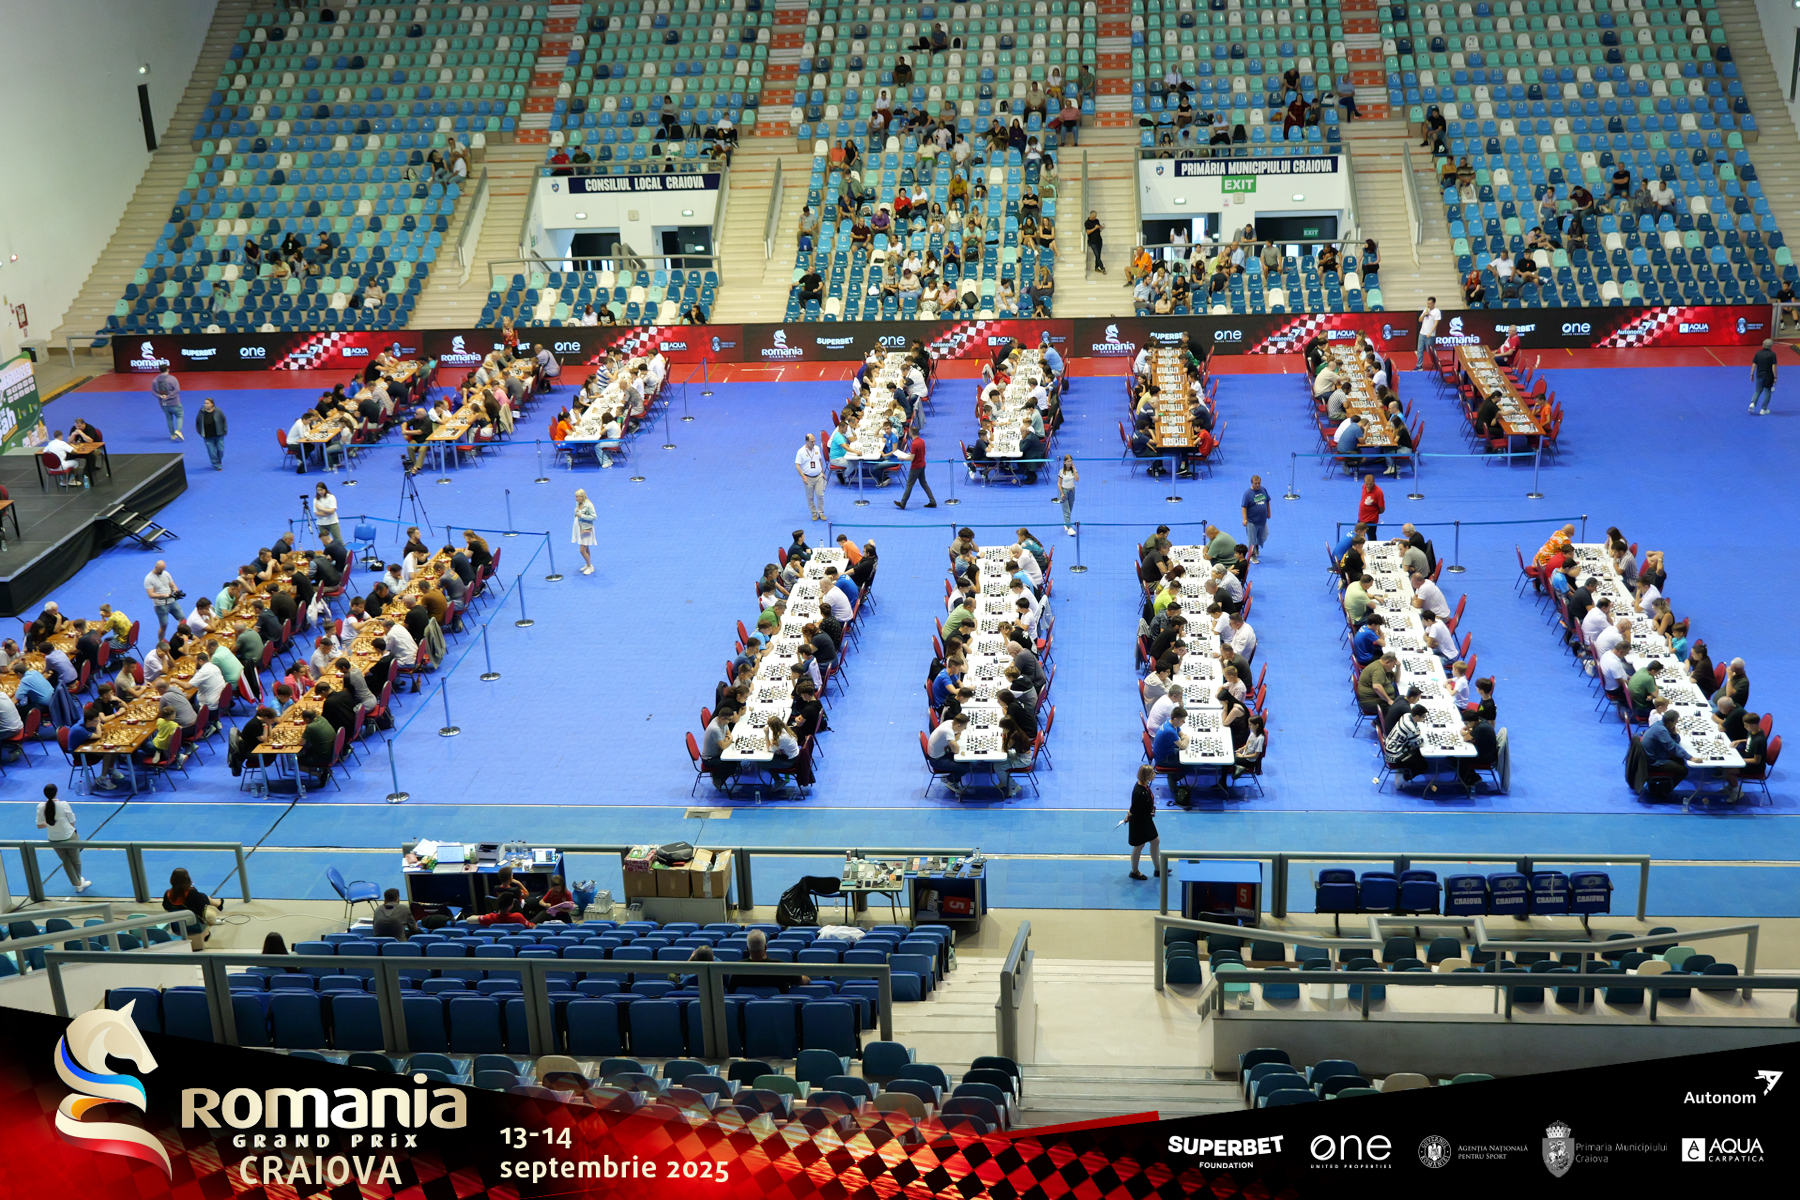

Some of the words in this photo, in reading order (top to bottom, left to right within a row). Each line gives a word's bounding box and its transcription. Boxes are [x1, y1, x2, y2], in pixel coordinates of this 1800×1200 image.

[1181, 160, 1226, 176] PRIMĂRIA
[1228, 160, 1291, 175] MUNICIPIULUI
[1293, 159, 1332, 173] CRAIOVA
[585, 177, 631, 192] CONSILIUL
[634, 176, 662, 190] LOCAL
[666, 175, 705, 189] CRAIOVA
[1224, 179, 1254, 190] EXIT
[1561, 322, 1591, 333] one
[1214, 330, 1242, 340] one
[554, 341, 581, 351] one
[816, 337, 854, 345] SUPERBET
[878, 336, 905, 346] one
[181, 348, 217, 357] SUPERBET
[239, 347, 266, 357] one
[1240, 888, 1247, 903] 5
[1536, 896, 1564, 904] CRAIOVA
[1576, 895, 1605, 903] CRAIOVA
[949, 901, 965, 910] 5
[1454, 897, 1482, 905] CRAIOVA
[1495, 897, 1524, 905] CRAIOVA
